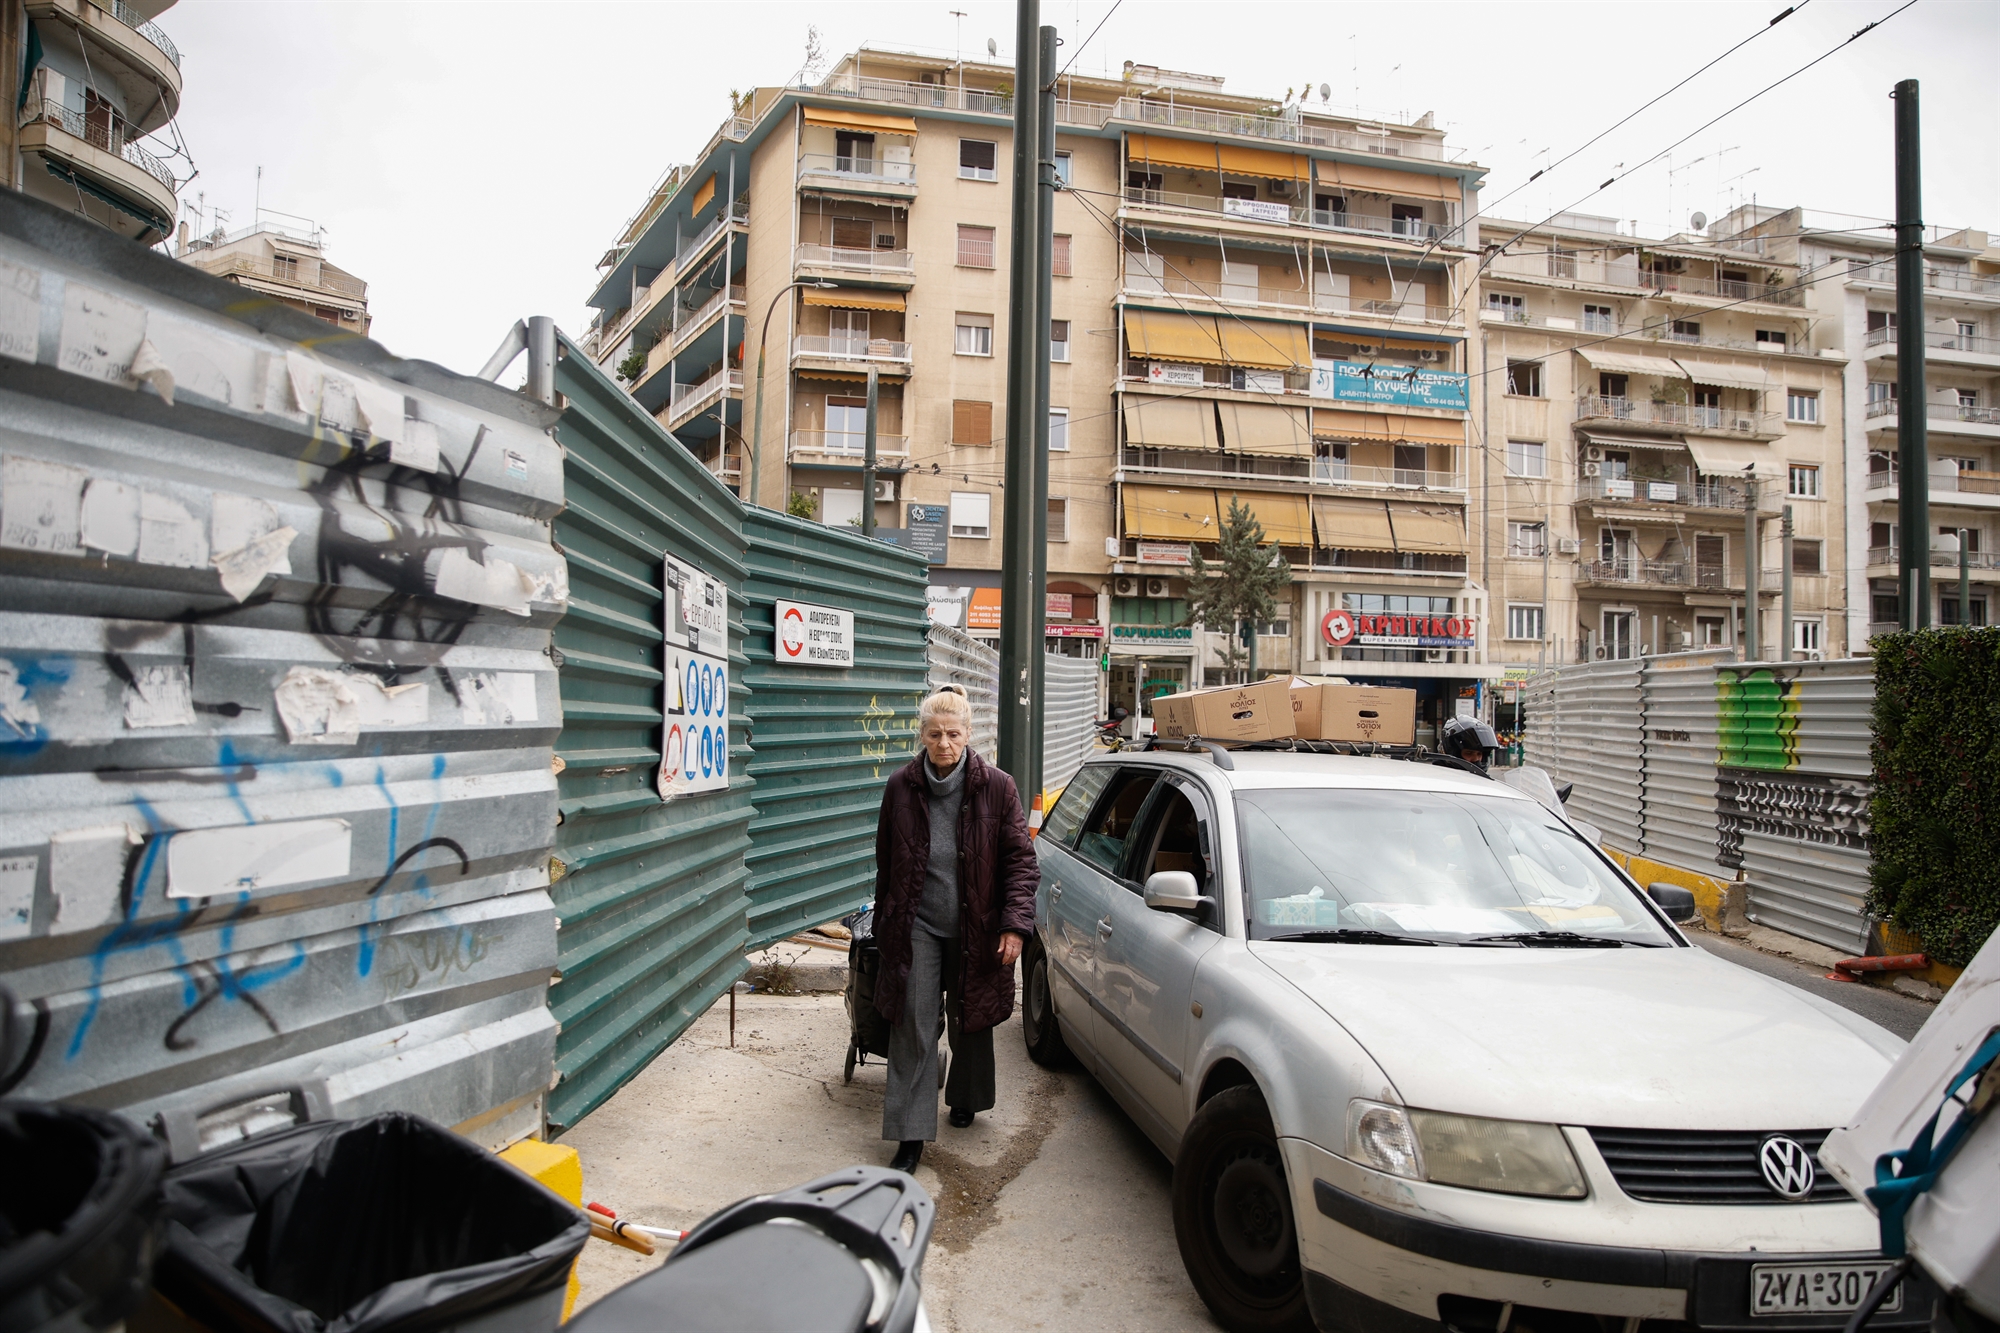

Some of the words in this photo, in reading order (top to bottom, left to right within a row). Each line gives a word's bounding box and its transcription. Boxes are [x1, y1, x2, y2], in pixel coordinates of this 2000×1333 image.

[1243, 202, 1287, 211] ΟΡΘΟΠΑΙΔΙΚΟ
[1338, 365, 1417, 383] ΠΟΔΛΟΓΙΚ
[1339, 389, 1371, 399] ΔΗΜΗΤΡΑ
[1372, 392, 1394, 400] ΙΑΤΡΟΥ
[1374, 380, 1432, 397] ΚΥΨΕΛΗΣ
[809, 611, 841, 626] ΑΠΑΓΟΡΕΥΕΤΑΙ
[1359, 615, 1475, 637] ΚΡΗΤΙΚΟΣ
[1113, 627, 1192, 639] ΦΑΡΜΑΚΕΙΟΝ
[1362, 636, 1386, 644] SUPER
[809, 646, 816, 658] ΜΗ
[1230, 699, 1256, 709] ΚΟΛΙΟΣ
[1356, 722, 1381, 730] KOLIOS
